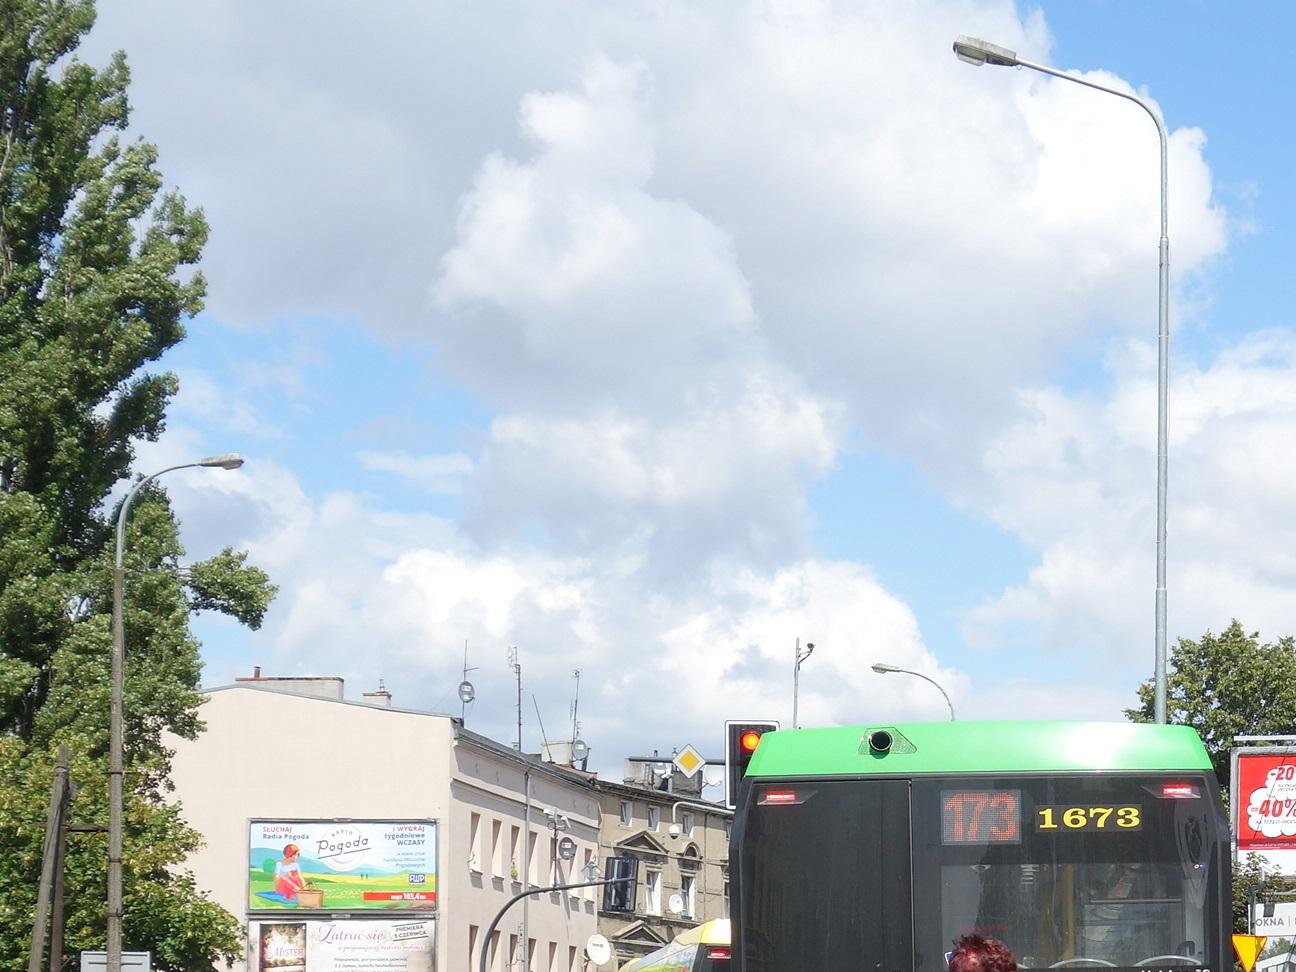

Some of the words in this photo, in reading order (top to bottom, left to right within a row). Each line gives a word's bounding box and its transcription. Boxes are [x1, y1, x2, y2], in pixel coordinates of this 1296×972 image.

[944, 792, 1017, 842] 173
[1039, 807, 1142, 830] 1673
[316, 834, 369, 855] Pogoda
[1255, 918, 1285, 927] OKNA
